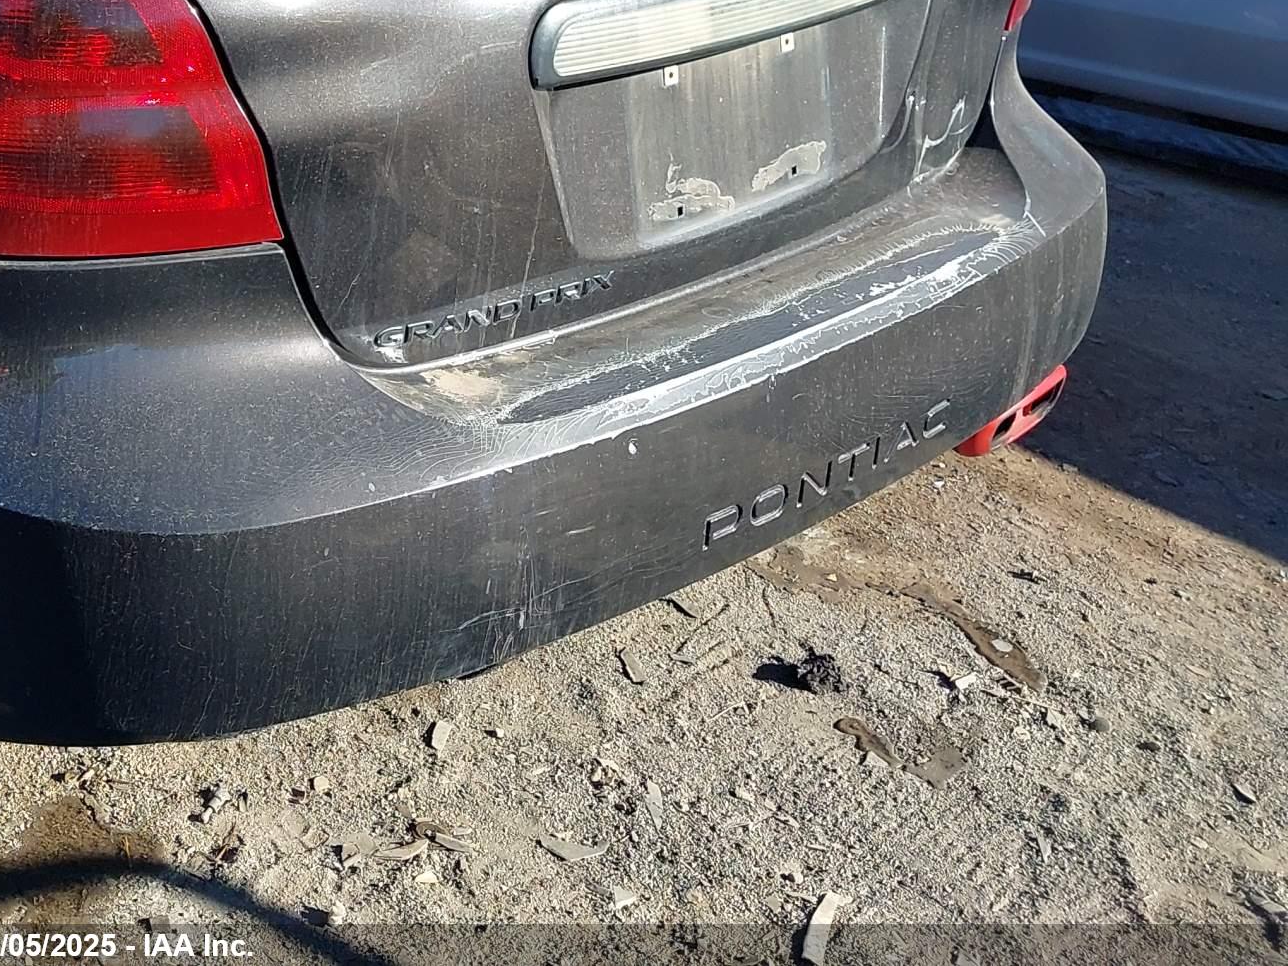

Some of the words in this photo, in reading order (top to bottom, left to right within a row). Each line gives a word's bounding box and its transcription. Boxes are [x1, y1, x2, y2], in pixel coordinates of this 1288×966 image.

[373, 298, 522, 347] GRAND
[528, 270, 614, 312] PRIX
[702, 398, 951, 551] PONTIAC
